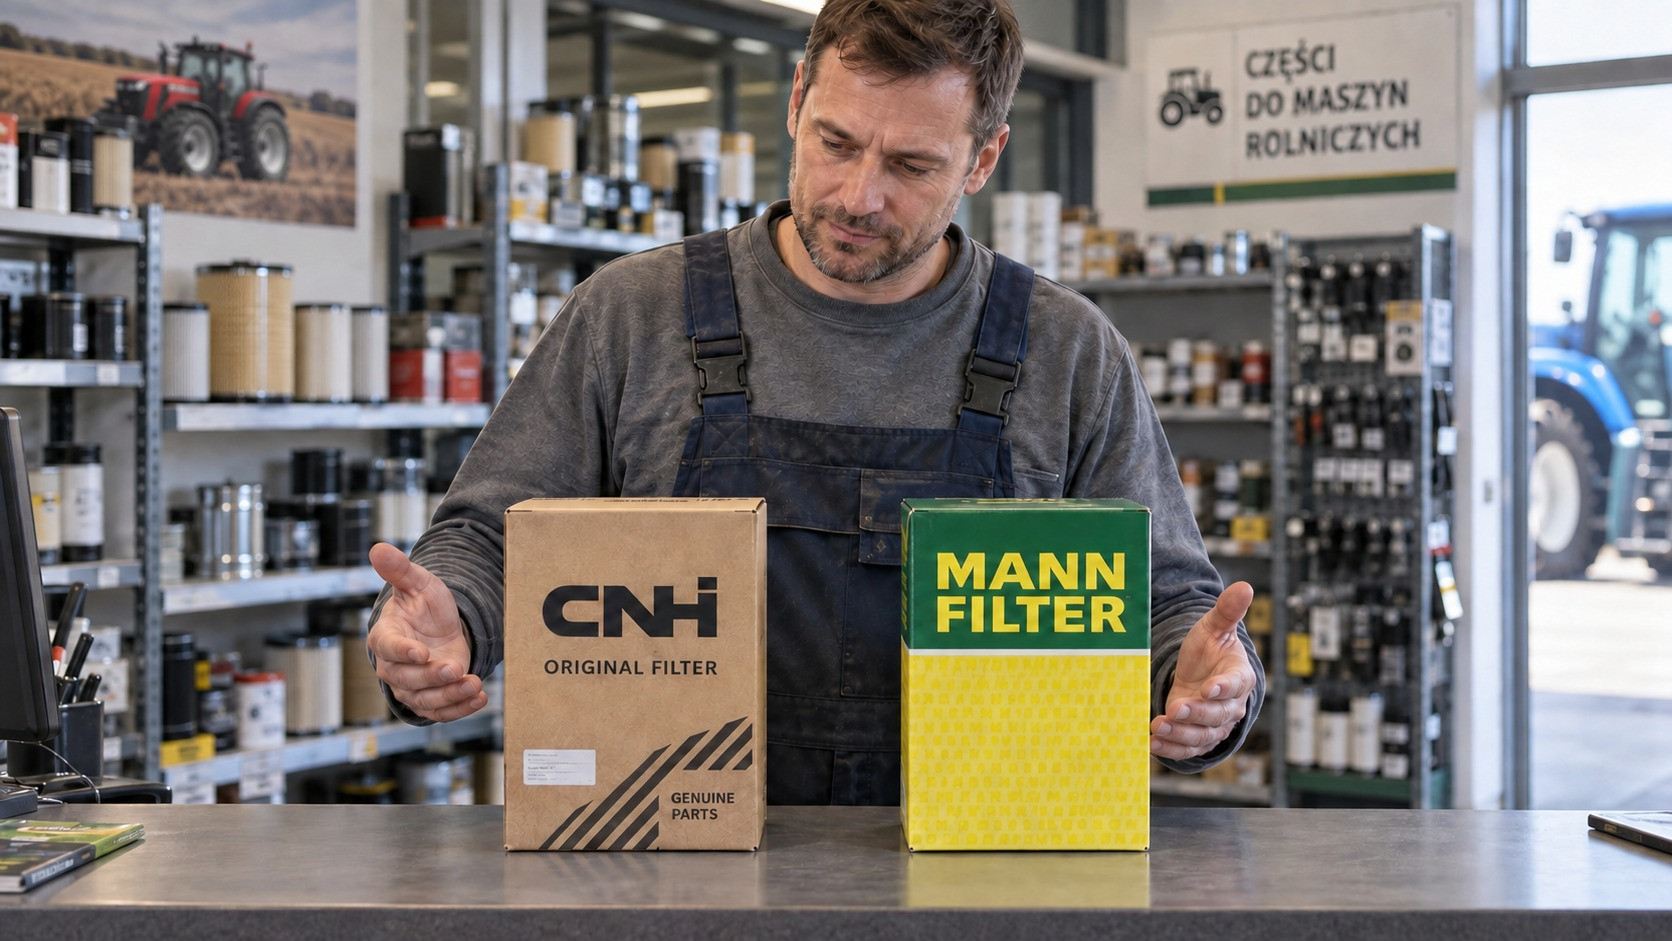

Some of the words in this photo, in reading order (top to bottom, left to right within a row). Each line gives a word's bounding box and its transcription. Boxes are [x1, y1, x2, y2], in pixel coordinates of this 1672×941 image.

[1245, 37, 1336, 83] CZĘŚCI
[1245, 90, 1284, 120] DO
[1293, 80, 1408, 117] MASZYN
[1245, 119, 1421, 159] ROLNICZYCH
[937, 552, 1125, 590] MANN
[937, 595, 1127, 633] FILTER
[544, 659, 644, 676] ORIGINAL
[652, 659, 718, 676] FILTER
[671, 791, 735, 805] GENUINE
[672, 807, 718, 821] PARTS
